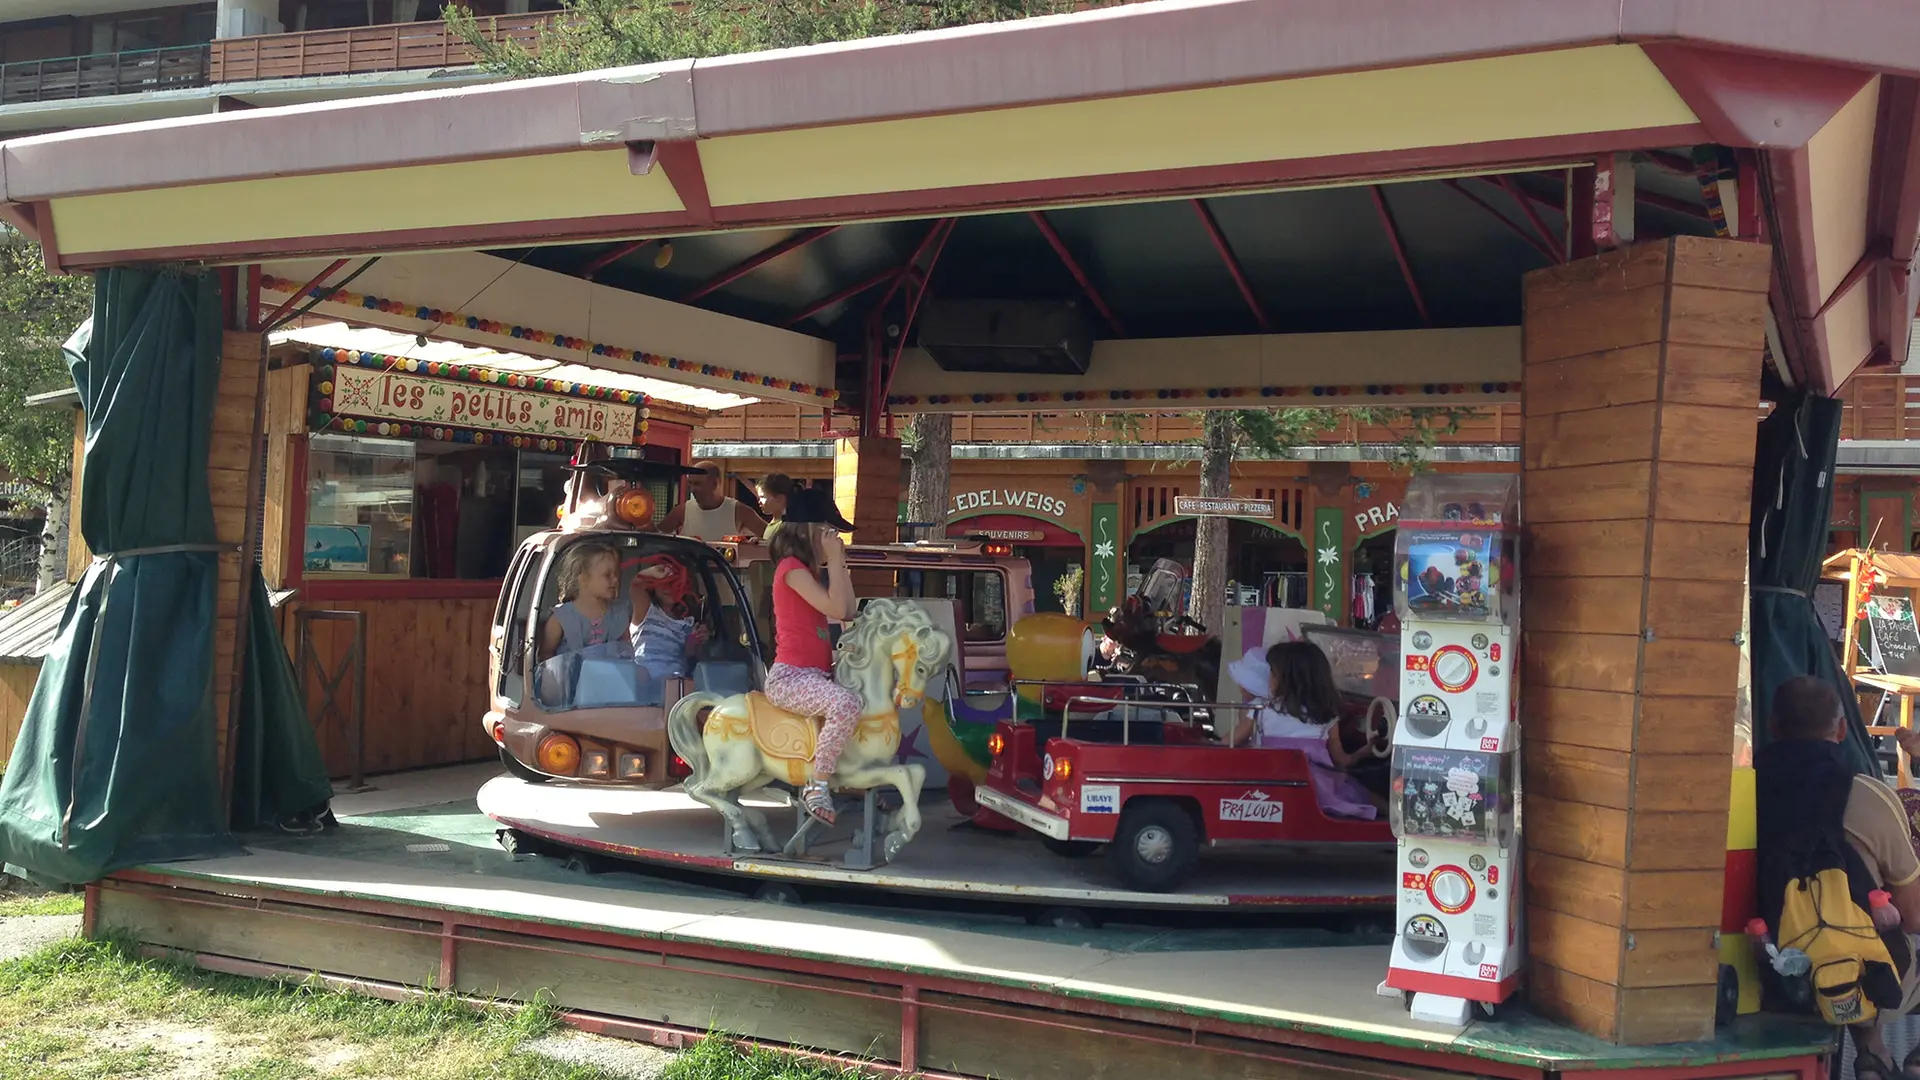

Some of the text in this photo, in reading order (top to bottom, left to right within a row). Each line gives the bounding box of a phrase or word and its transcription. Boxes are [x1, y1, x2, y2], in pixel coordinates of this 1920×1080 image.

[381, 375, 605, 433] les petits amis
[946, 489, 1067, 517] 'EDELWEISS
[1200, 502, 1240, 512] RESTAURANT
[1244, 503, 1272, 513] PIZZERIA
[1354, 501, 1400, 532] PRA
[978, 530, 1030, 540] SOUVENIRS
[1086, 794, 1113, 802] UBAYE
